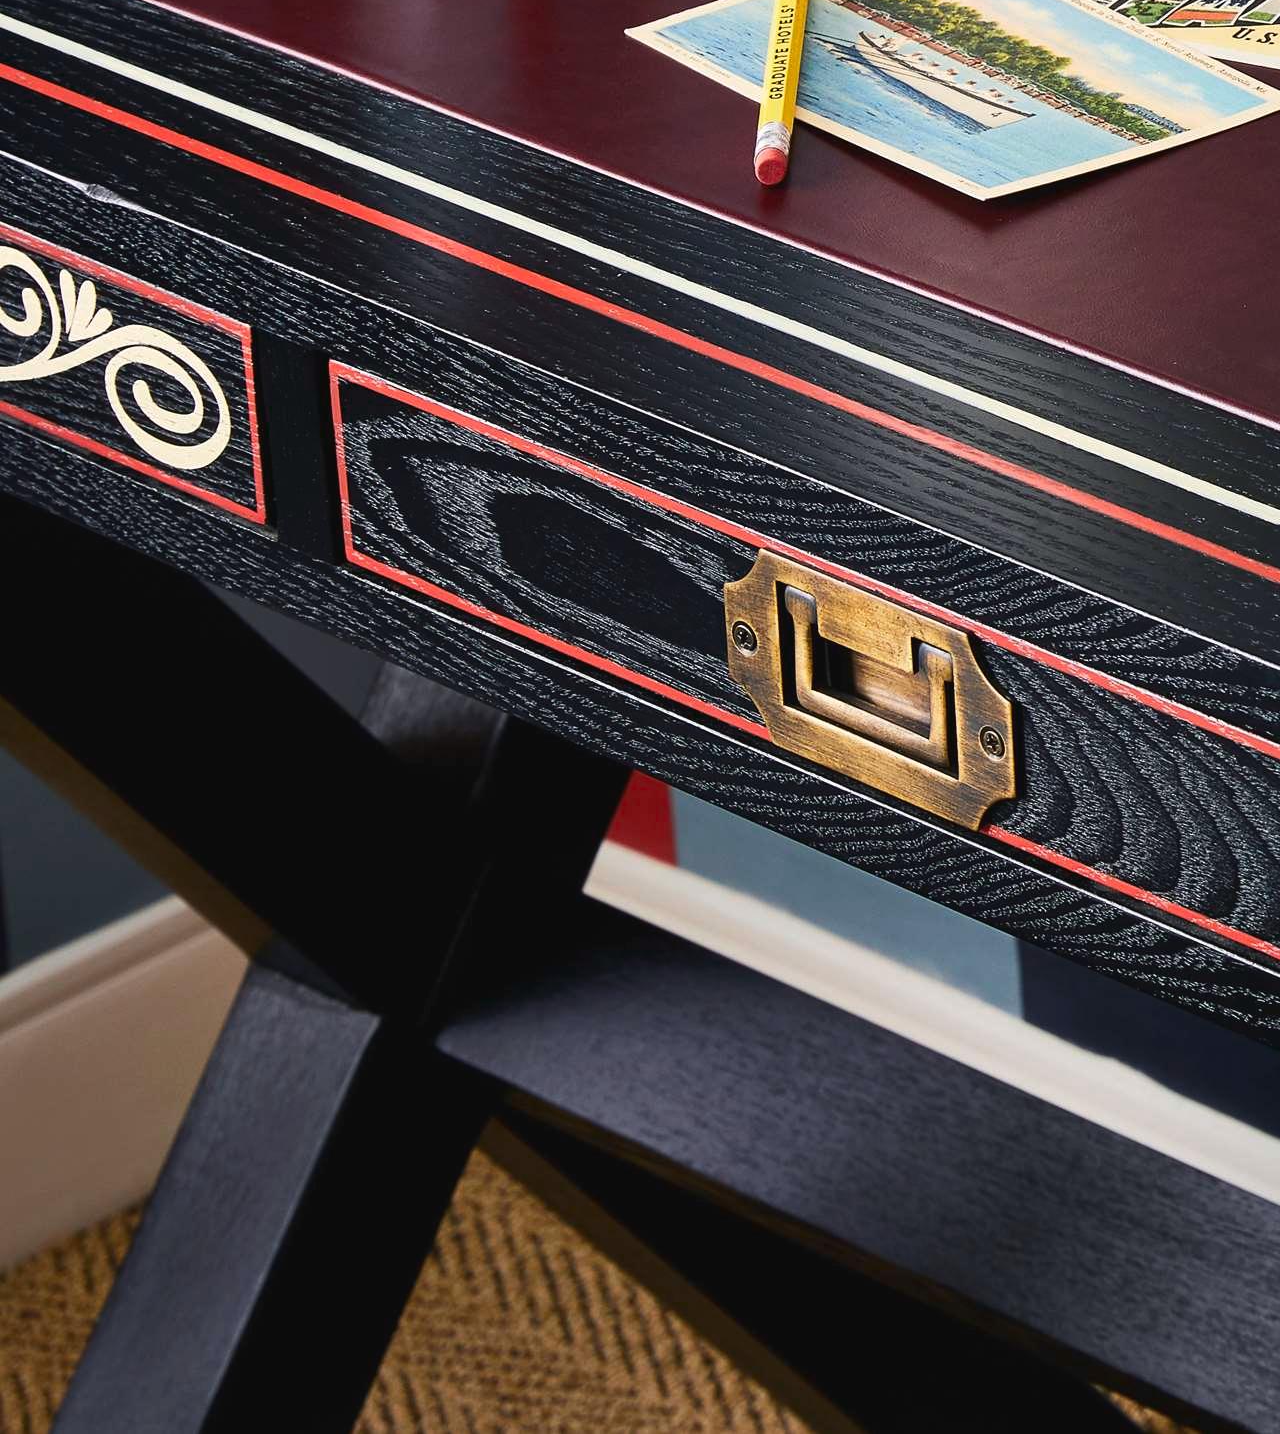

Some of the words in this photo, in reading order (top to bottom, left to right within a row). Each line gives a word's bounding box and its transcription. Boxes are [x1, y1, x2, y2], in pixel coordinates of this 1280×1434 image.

[1231, 27, 1255, 41] U.
[1256, 31, 1278, 45] S.
[769, 47, 789, 100] GRADUATE
